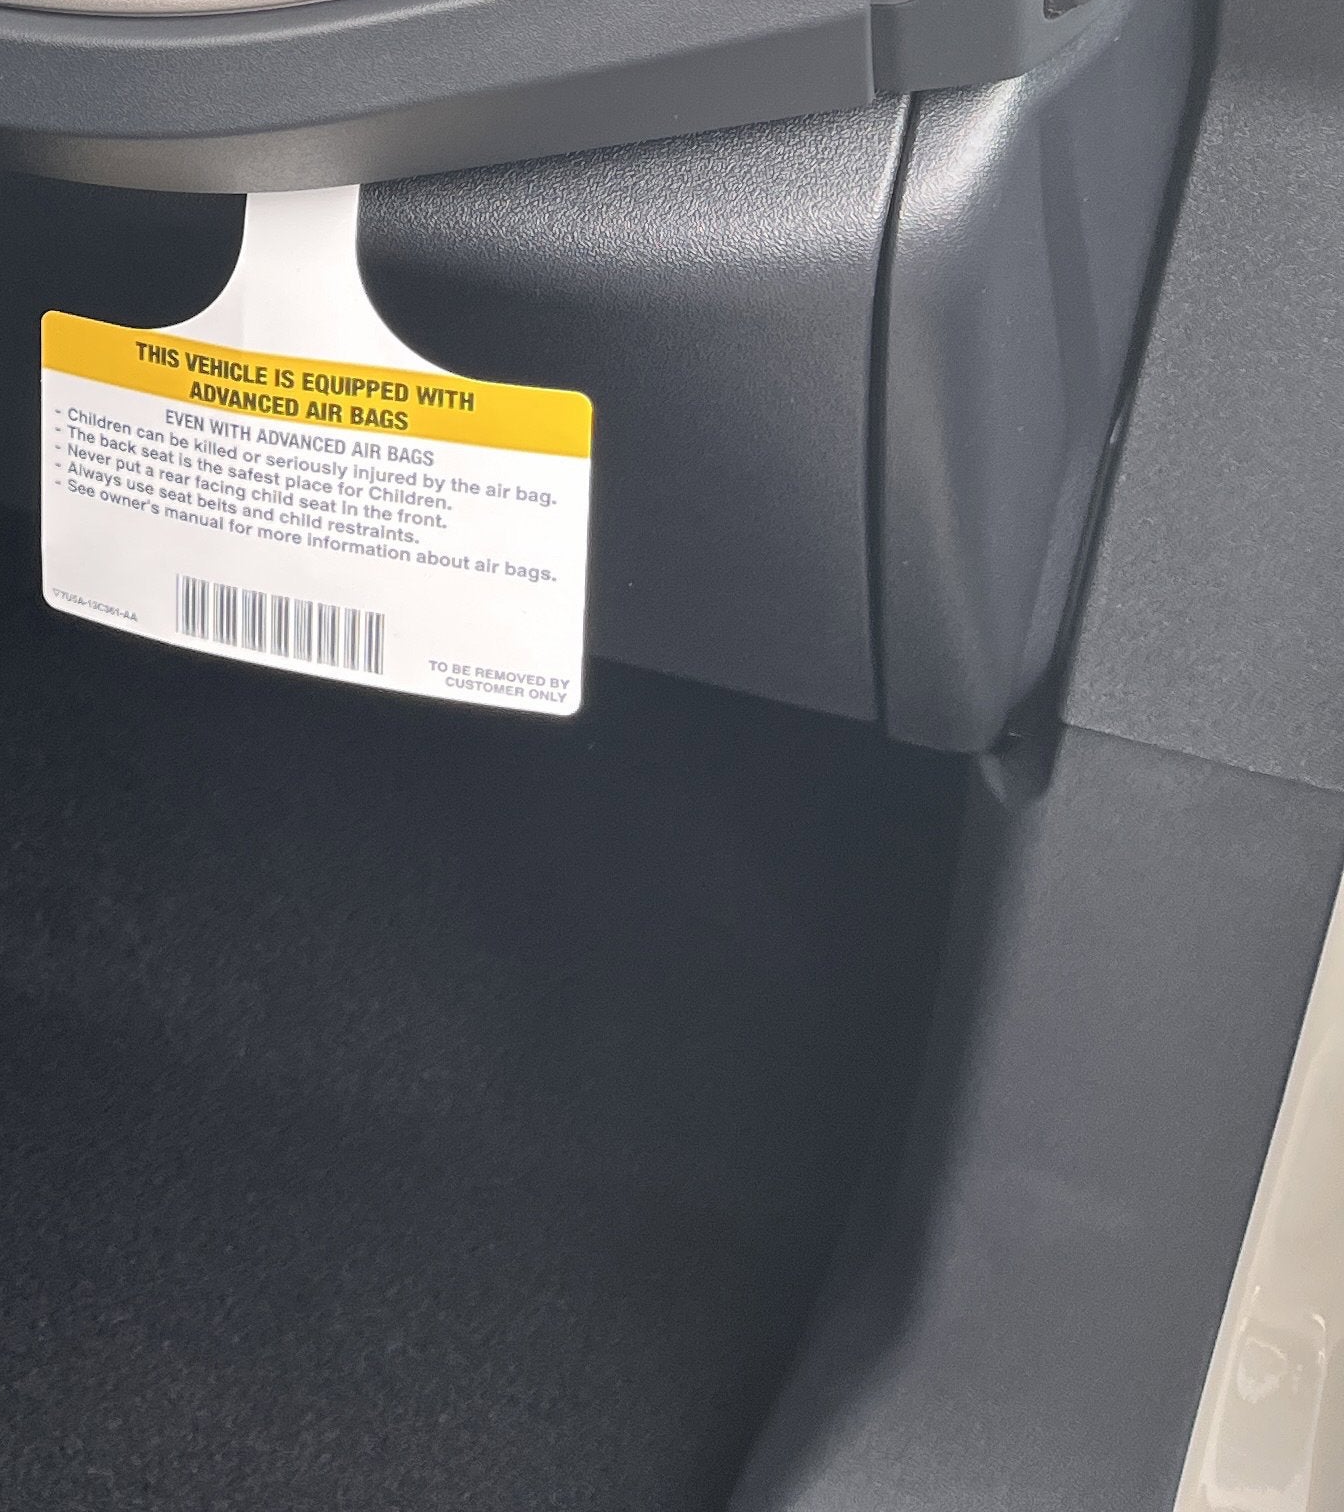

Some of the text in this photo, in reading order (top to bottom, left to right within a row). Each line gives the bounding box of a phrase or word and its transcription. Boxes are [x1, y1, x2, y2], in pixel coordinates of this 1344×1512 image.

[135, 341, 475, 412] THIS VEHICLE IS EQUIPPED WITH
[189, 380, 409, 431] ADVANCED AIR BAGS
[67, 407, 557, 507] Children can be killed or seriously injured by the air bag.
[67, 424, 452, 511] The back seat is the safest place for Children.
[165, 408, 434, 467] EVEN WITH ADVANCED AIR BAGS
[67, 443, 447, 529] Never put a rear facing child seat in the front.
[67, 461, 419, 544] Always use seat belts and child restraints.
[67, 478, 557, 583] See owner's manual for more information about air bags.
[429, 659, 570, 689] TO BE REMOVED BY
[445, 676, 568, 703] CUSTOMER ONLY
